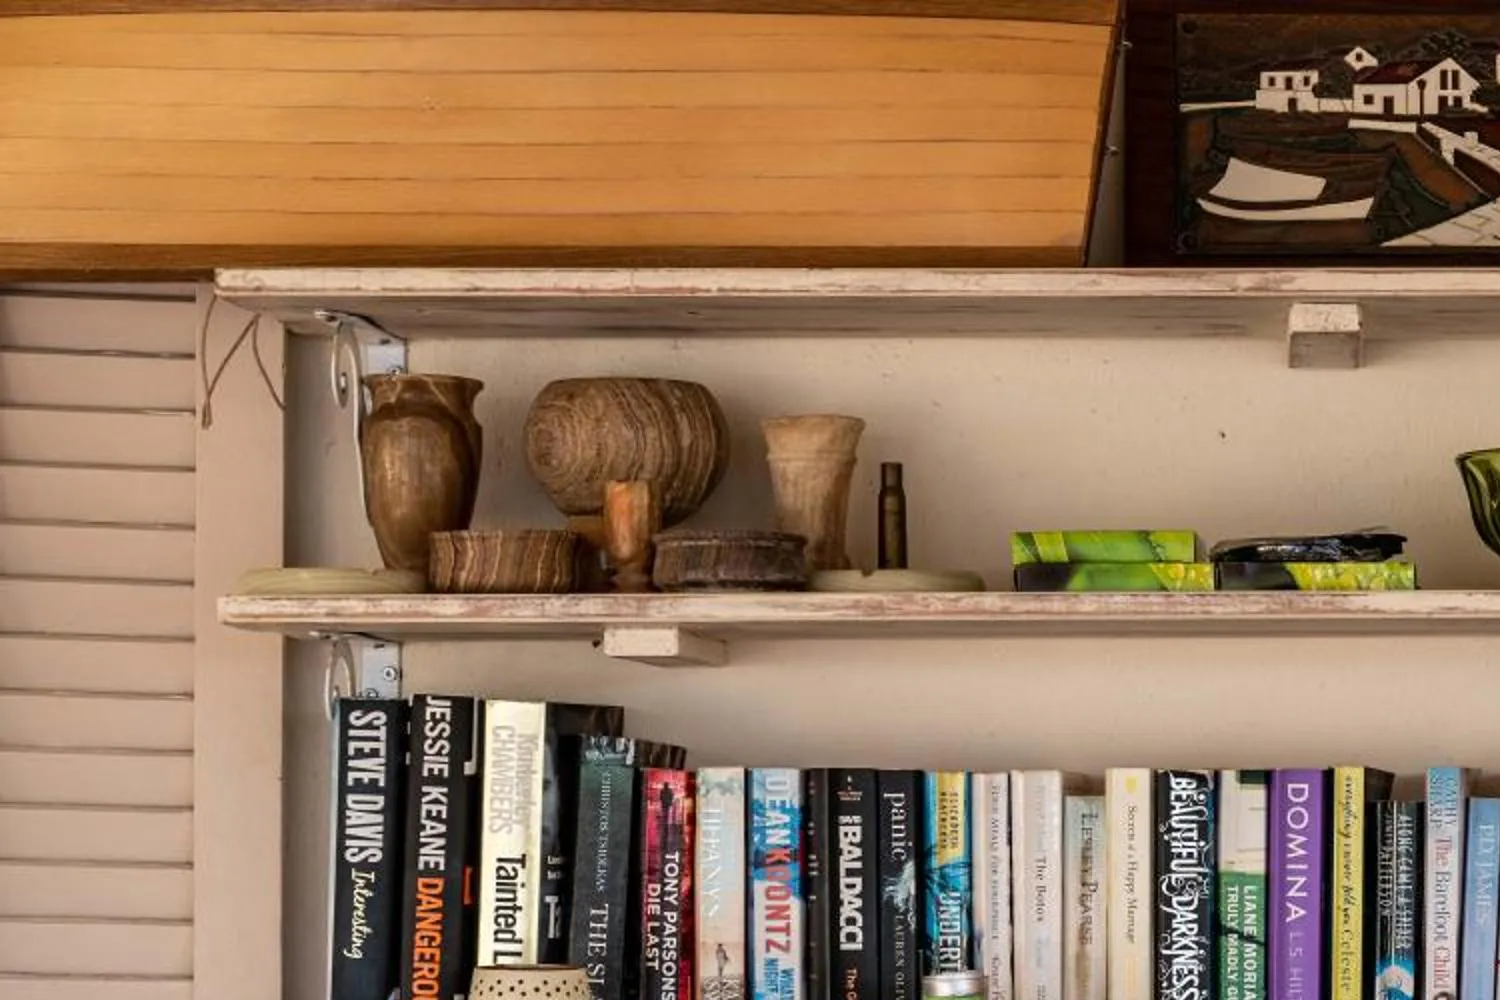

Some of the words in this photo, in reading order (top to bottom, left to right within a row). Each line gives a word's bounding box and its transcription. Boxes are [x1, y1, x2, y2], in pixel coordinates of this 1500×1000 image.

[348, 710, 387, 788] STEVE
[424, 696, 451, 779] JESSIE
[489, 725, 515, 836] CHAMBERS
[764, 776, 792, 846] DEAN
[343, 792, 385, 865] DAVIS
[416, 786, 450, 871] KEANE
[882, 791, 914, 862] panic
[1080, 813, 1100, 877] LESLEY
[1126, 805, 1139, 842] Secrets
[1164, 776, 1207, 884] BEAUTIFUL
[1286, 783, 1310, 923] DOMINA
[1435, 836, 1453, 868] The
[493, 853, 527, 943] Tainted
[646, 883, 661, 917] DIE
[663, 851, 680, 902] TONY
[764, 847, 792, 955] KOONTZ
[839, 826, 863, 952] BALDACCI
[1036, 857, 1048, 881] The
[1125, 861, 1139, 895] Happy
[1476, 860, 1493, 927] JAMES
[344, 868, 375, 960] Interesting
[587, 903, 611, 959] THE
[1035, 885, 1047, 922] Botox
[1080, 881, 1099, 946] PEARSE
[1124, 897, 1138, 944] Marriage
[1226, 885, 1240, 928] TRULY
[1243, 885, 1258, 937] LIANE
[1433, 870, 1452, 943] Barefoot
[645, 921, 661, 971] LAST
[894, 915, 907, 967] LAUREN
[1226, 933, 1240, 981] MADLY
[1340, 929, 1354, 993] Celeste
[1432, 946, 1451, 989] Child
